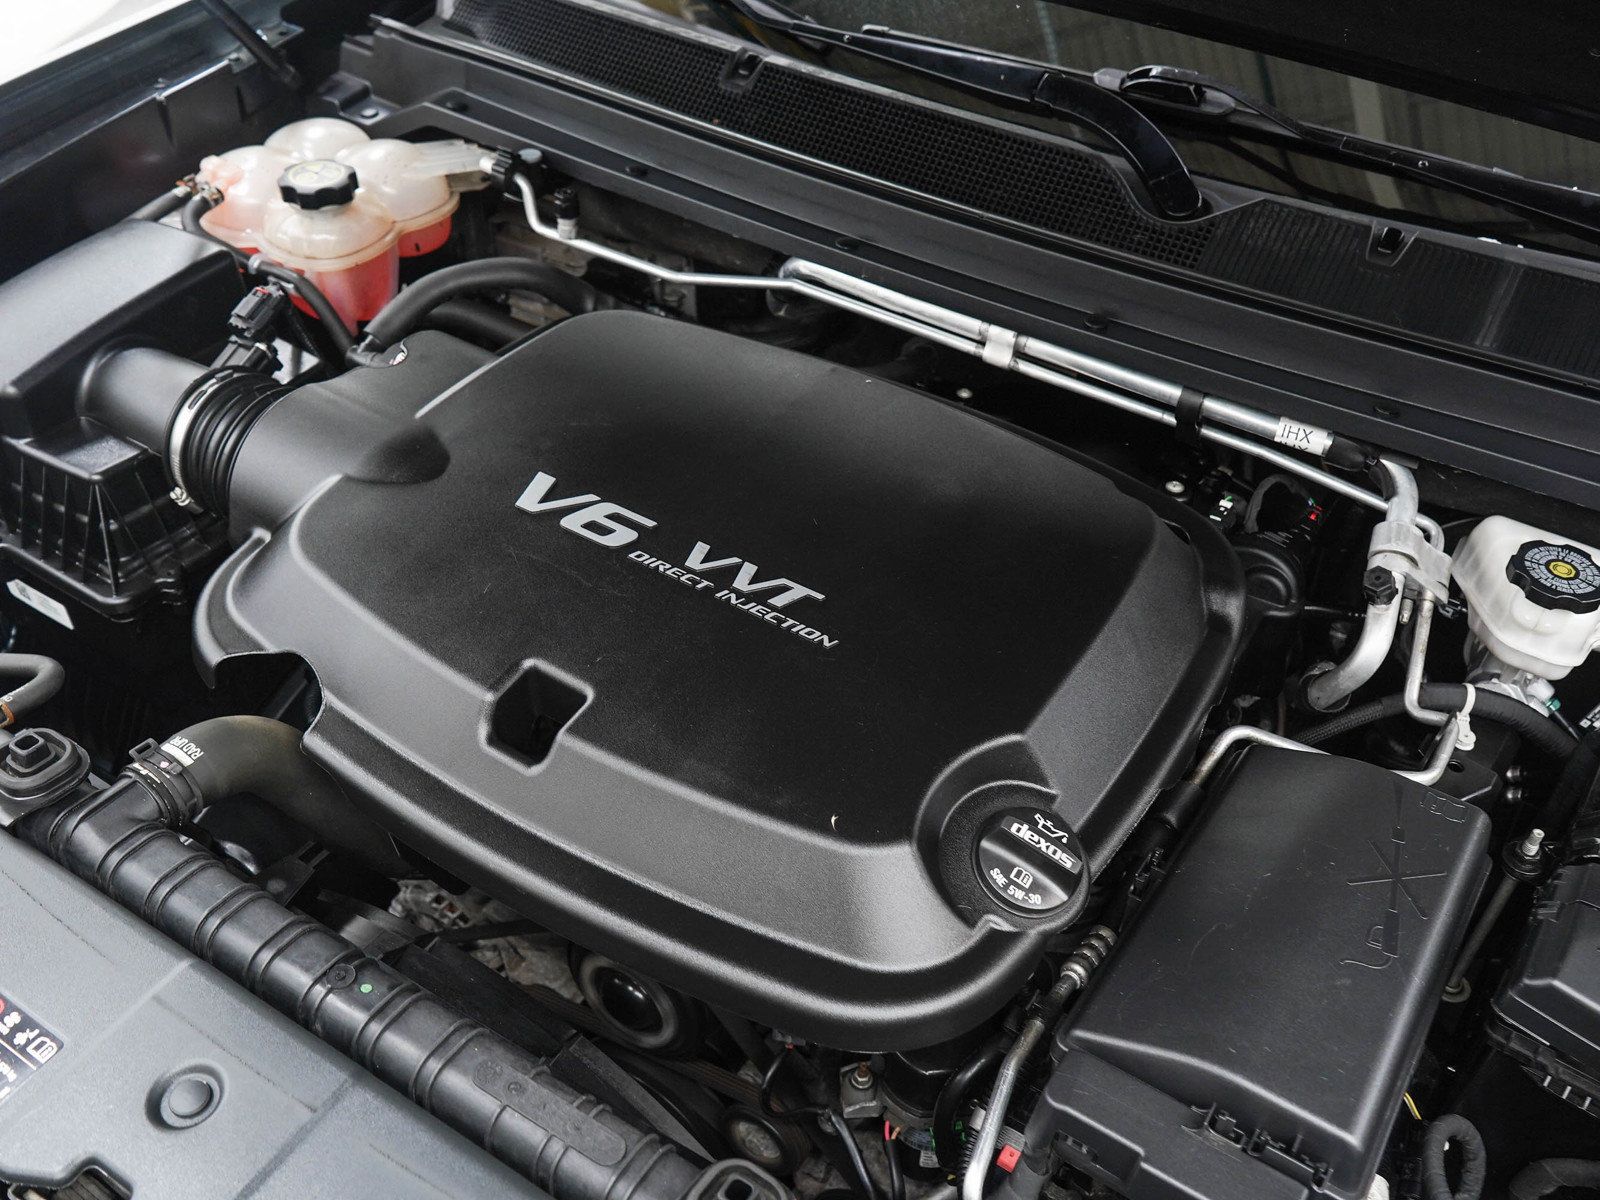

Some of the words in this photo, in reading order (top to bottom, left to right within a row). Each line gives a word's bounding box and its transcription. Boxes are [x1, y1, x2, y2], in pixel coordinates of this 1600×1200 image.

[1281, 424, 1314, 444] IHX
[514, 471, 657, 548] V6
[684, 540, 826, 608] VVT
[627, 550, 714, 591] DIRECT
[714, 589, 839, 649] INJECTION
[1010, 822, 1076, 868] dexos
[989, 867, 1009, 888] SAE
[1007, 884, 1042, 905] 5W-30
